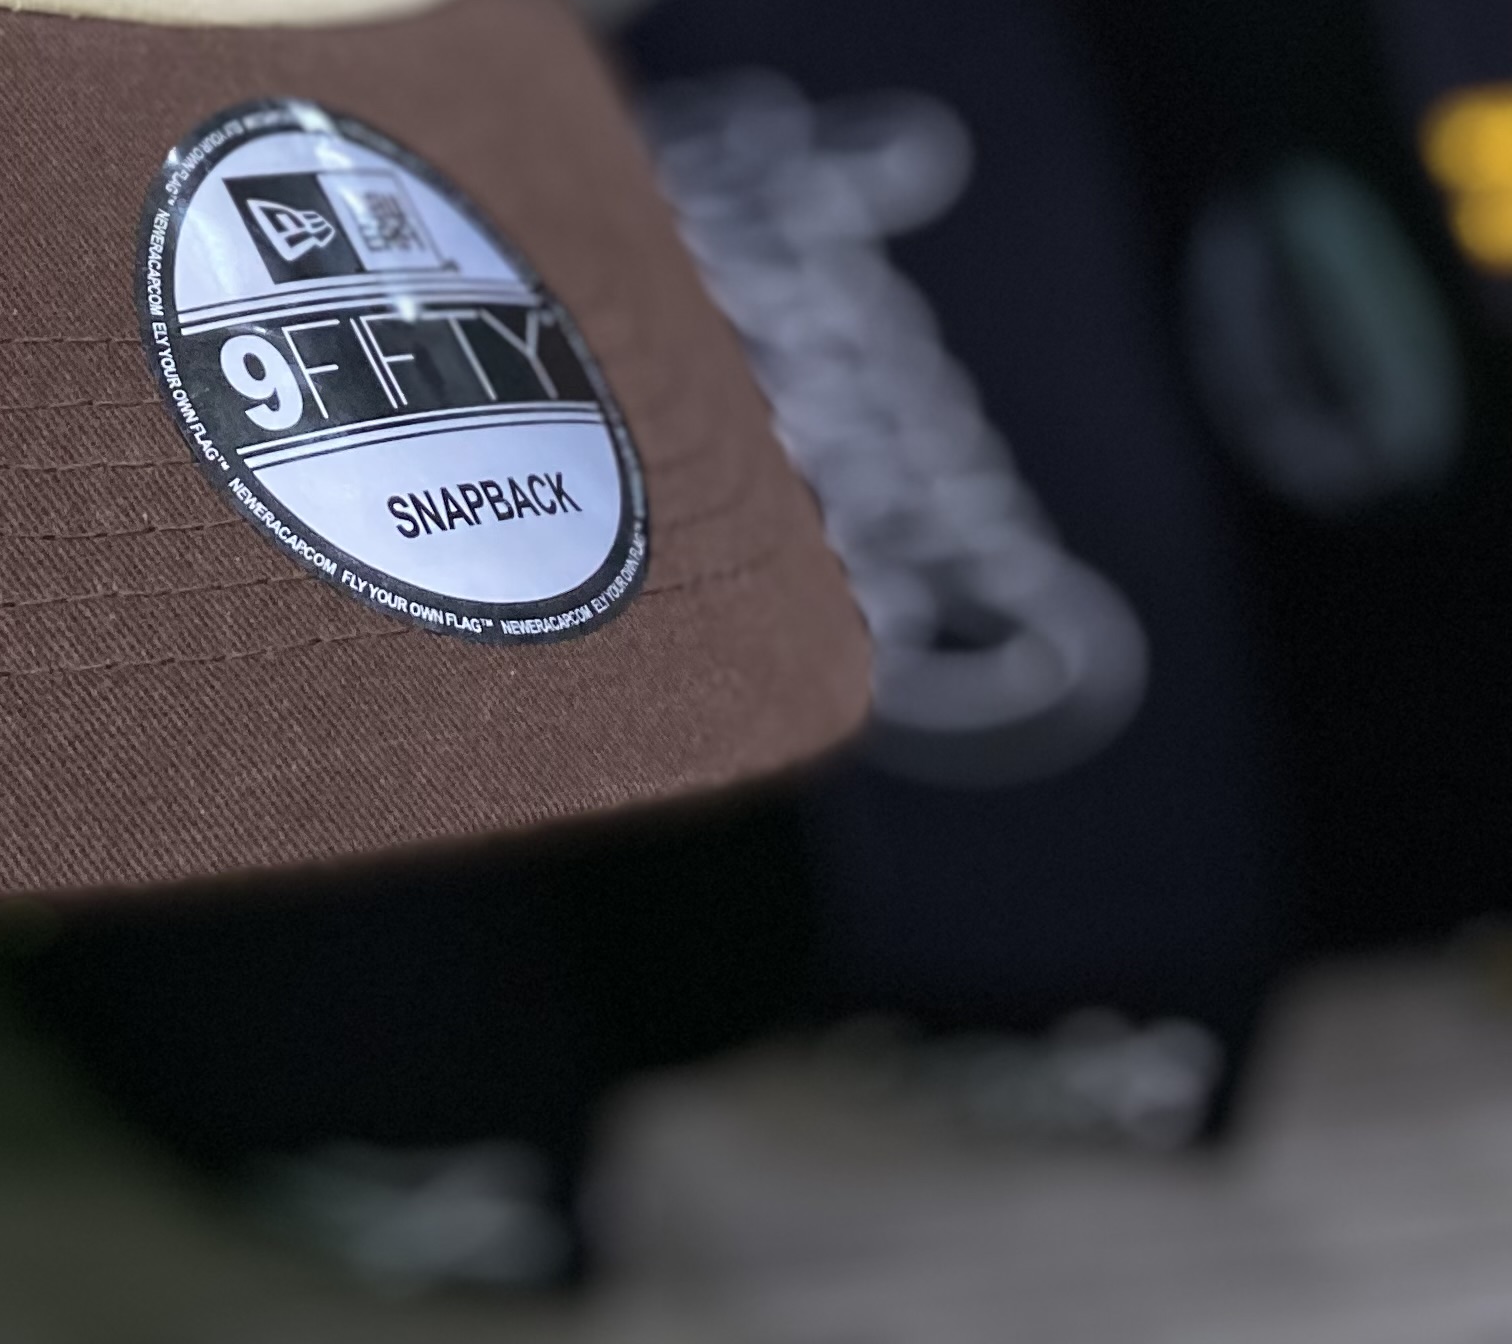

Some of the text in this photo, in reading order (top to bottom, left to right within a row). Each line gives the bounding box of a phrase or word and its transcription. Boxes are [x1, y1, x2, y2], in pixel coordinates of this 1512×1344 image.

[159, 348, 182, 389] YOUR
[173, 389, 199, 423] OWN
[220, 307, 559, 432] 9FIFTY
[387, 471, 583, 539] SNAPBACK
[341, 569, 367, 593] FLY
[369, 583, 408, 613] YOUR
[409, 601, 444, 625] OWN
[606, 575, 629, 602] YOUR
